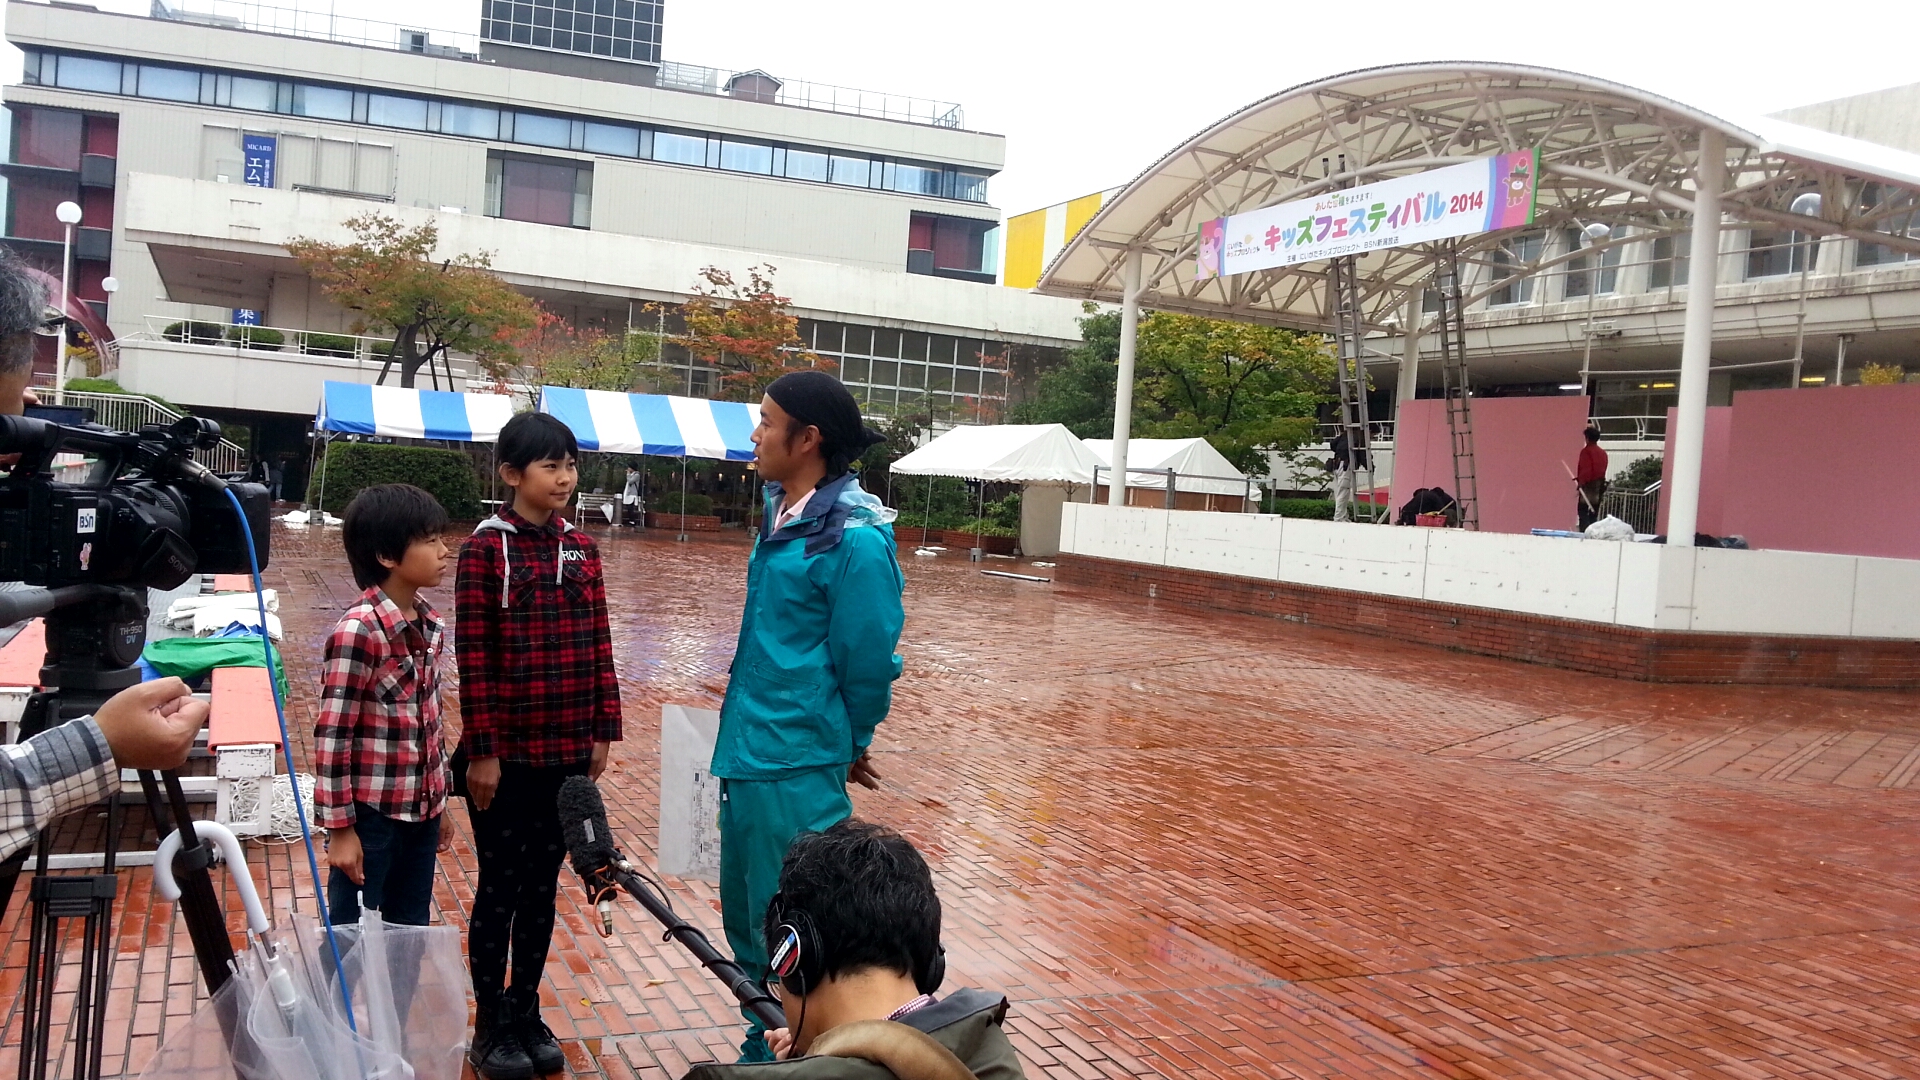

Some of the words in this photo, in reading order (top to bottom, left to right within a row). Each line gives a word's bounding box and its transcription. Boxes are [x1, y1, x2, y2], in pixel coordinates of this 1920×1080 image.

[1264, 190, 1446, 252] キッズフェスティバル
[1449, 190, 1484, 214] 2014
[167, 555, 188, 575] SONY
[120, 625, 143, 636] TH-950
[126, 635, 137, 645] DV
